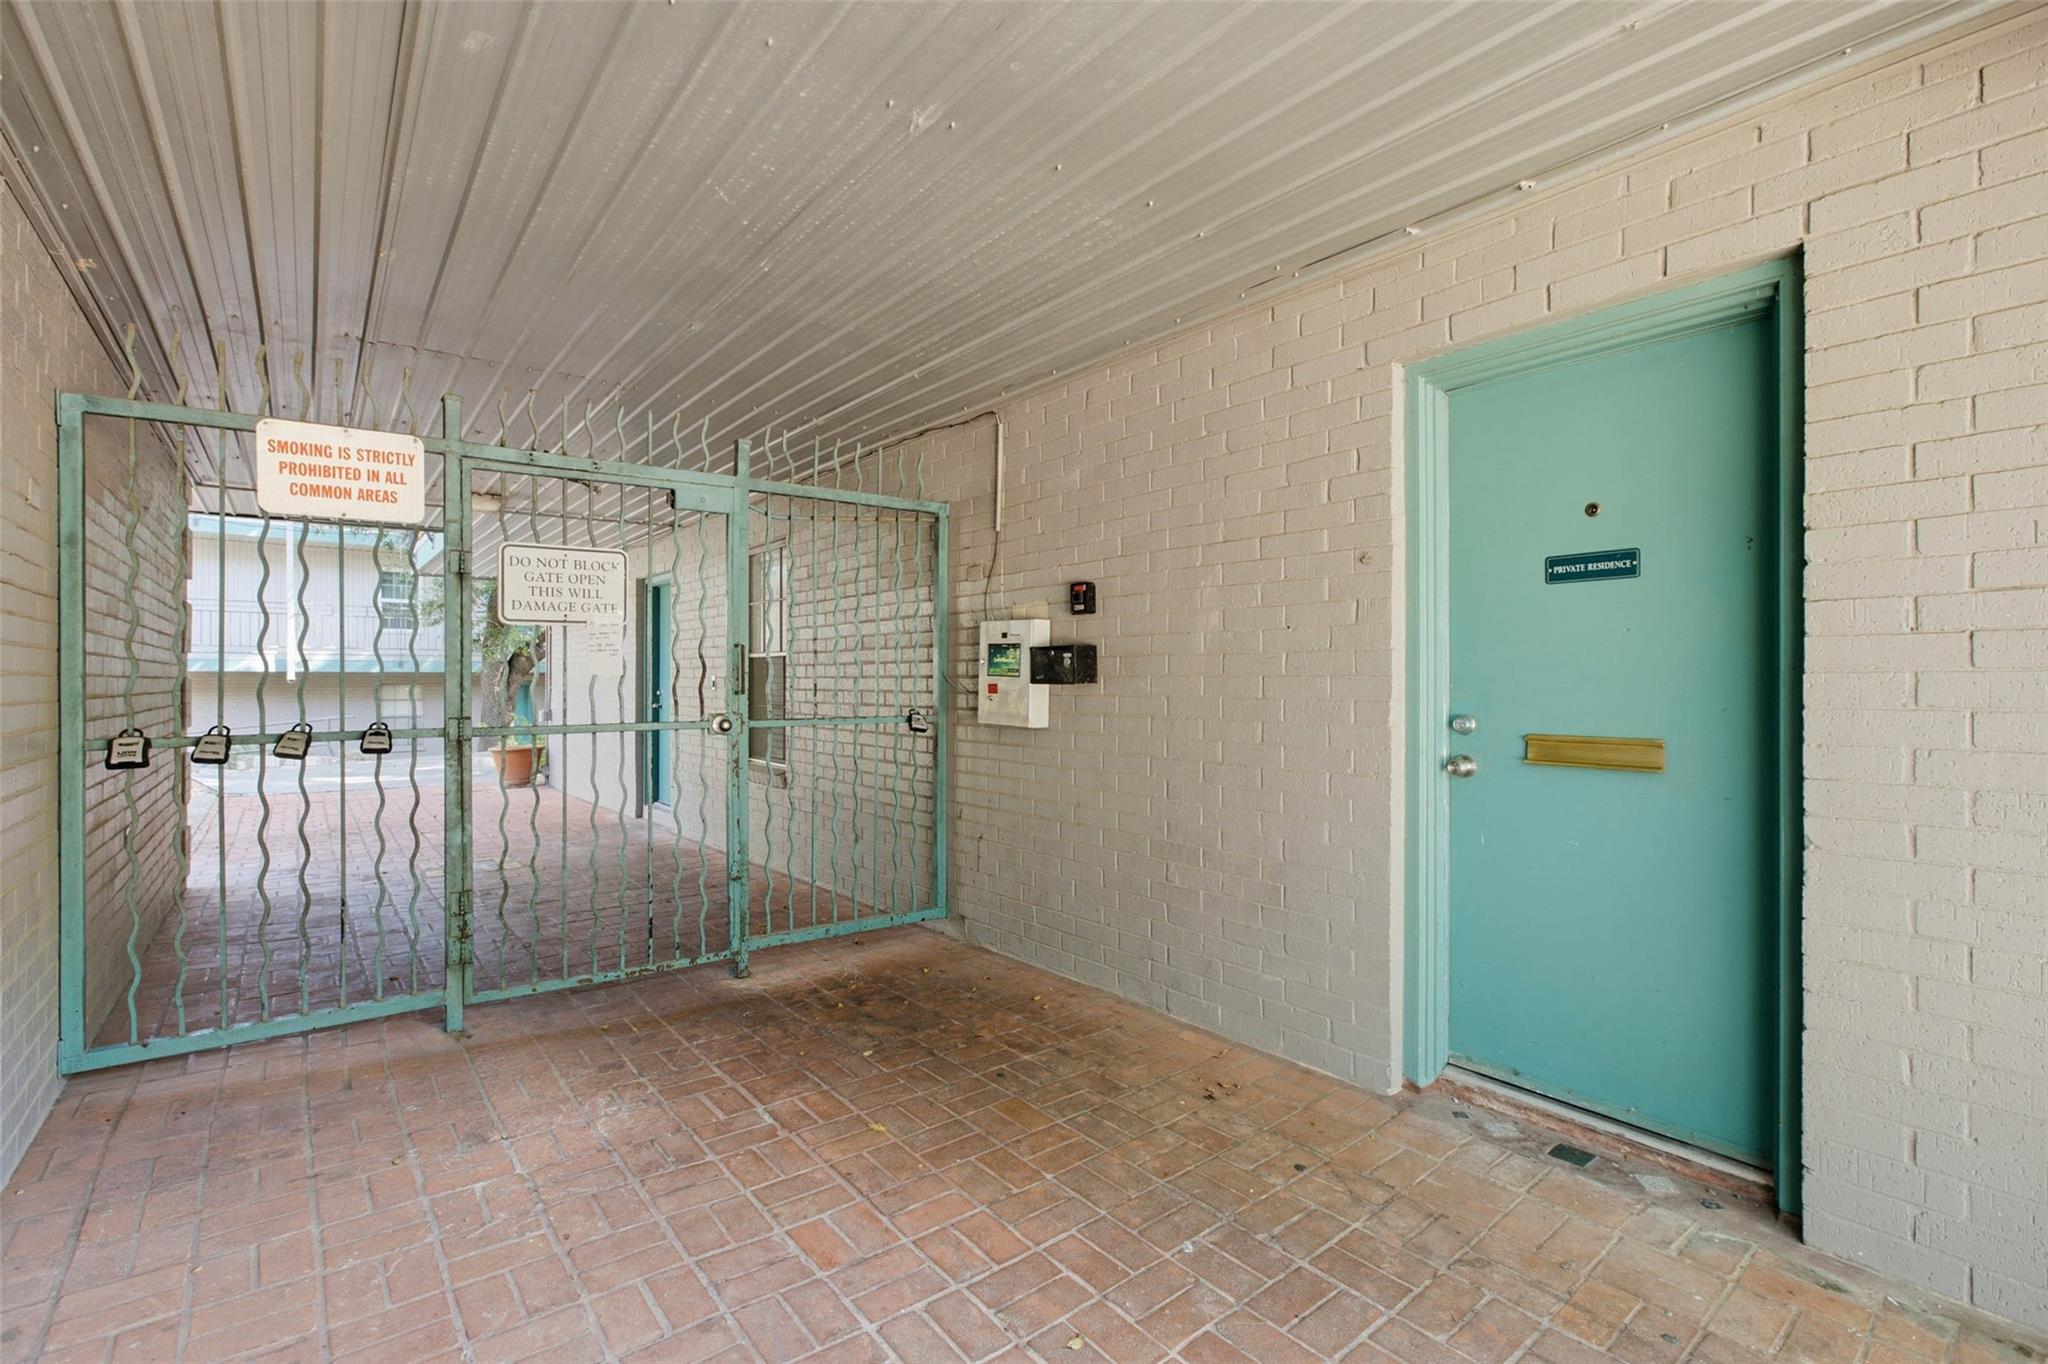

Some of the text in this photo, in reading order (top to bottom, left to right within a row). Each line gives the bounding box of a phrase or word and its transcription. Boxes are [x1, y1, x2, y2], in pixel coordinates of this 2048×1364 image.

[267, 439, 416, 467] SMOKING IS STRICTLY
[279, 461, 407, 485] PROHIBITED IN ALL
[289, 482, 398, 504] COMMON AREAS
[509, 555, 620, 573] DO NOT BLOCK
[1553, 559, 1632, 574] PRIVATE RESIDENCE
[523, 571, 606, 585] GATE OPEN
[528, 585, 604, 600] THIS WILL
[511, 599, 618, 614] DAMAGE GATE
